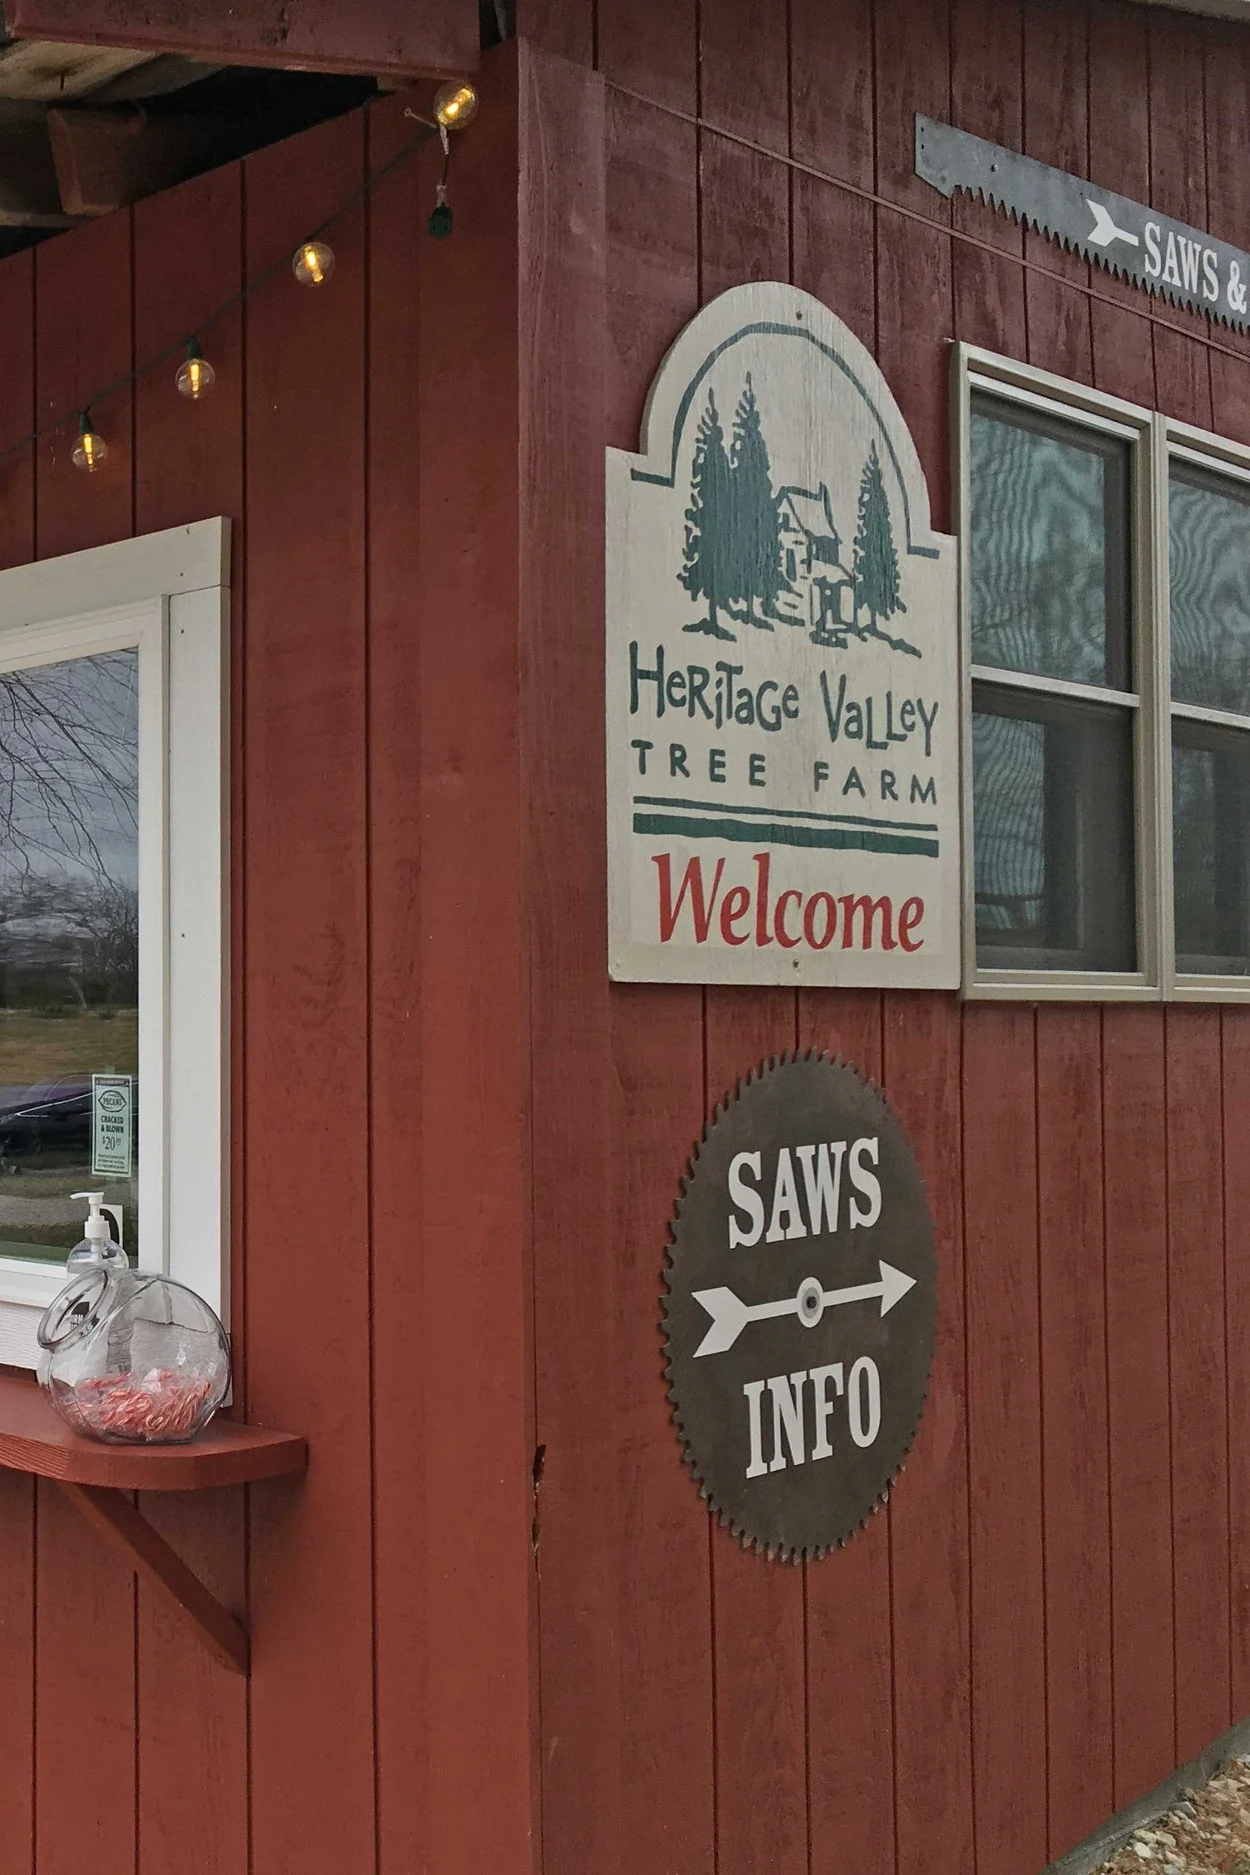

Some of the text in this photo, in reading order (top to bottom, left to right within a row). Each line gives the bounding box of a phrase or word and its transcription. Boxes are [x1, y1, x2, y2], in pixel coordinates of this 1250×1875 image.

[1144, 222, 1247, 314] SAWS &
[631, 739, 938, 805] TREE FARM
[651, 852, 925, 953] Welcome
[100, 1115, 124, 1124] CRACKED
[106, 1125, 124, 1134] BLOWN
[728, 1136, 883, 1249] SAWS
[743, 1356, 881, 1479] INFO
